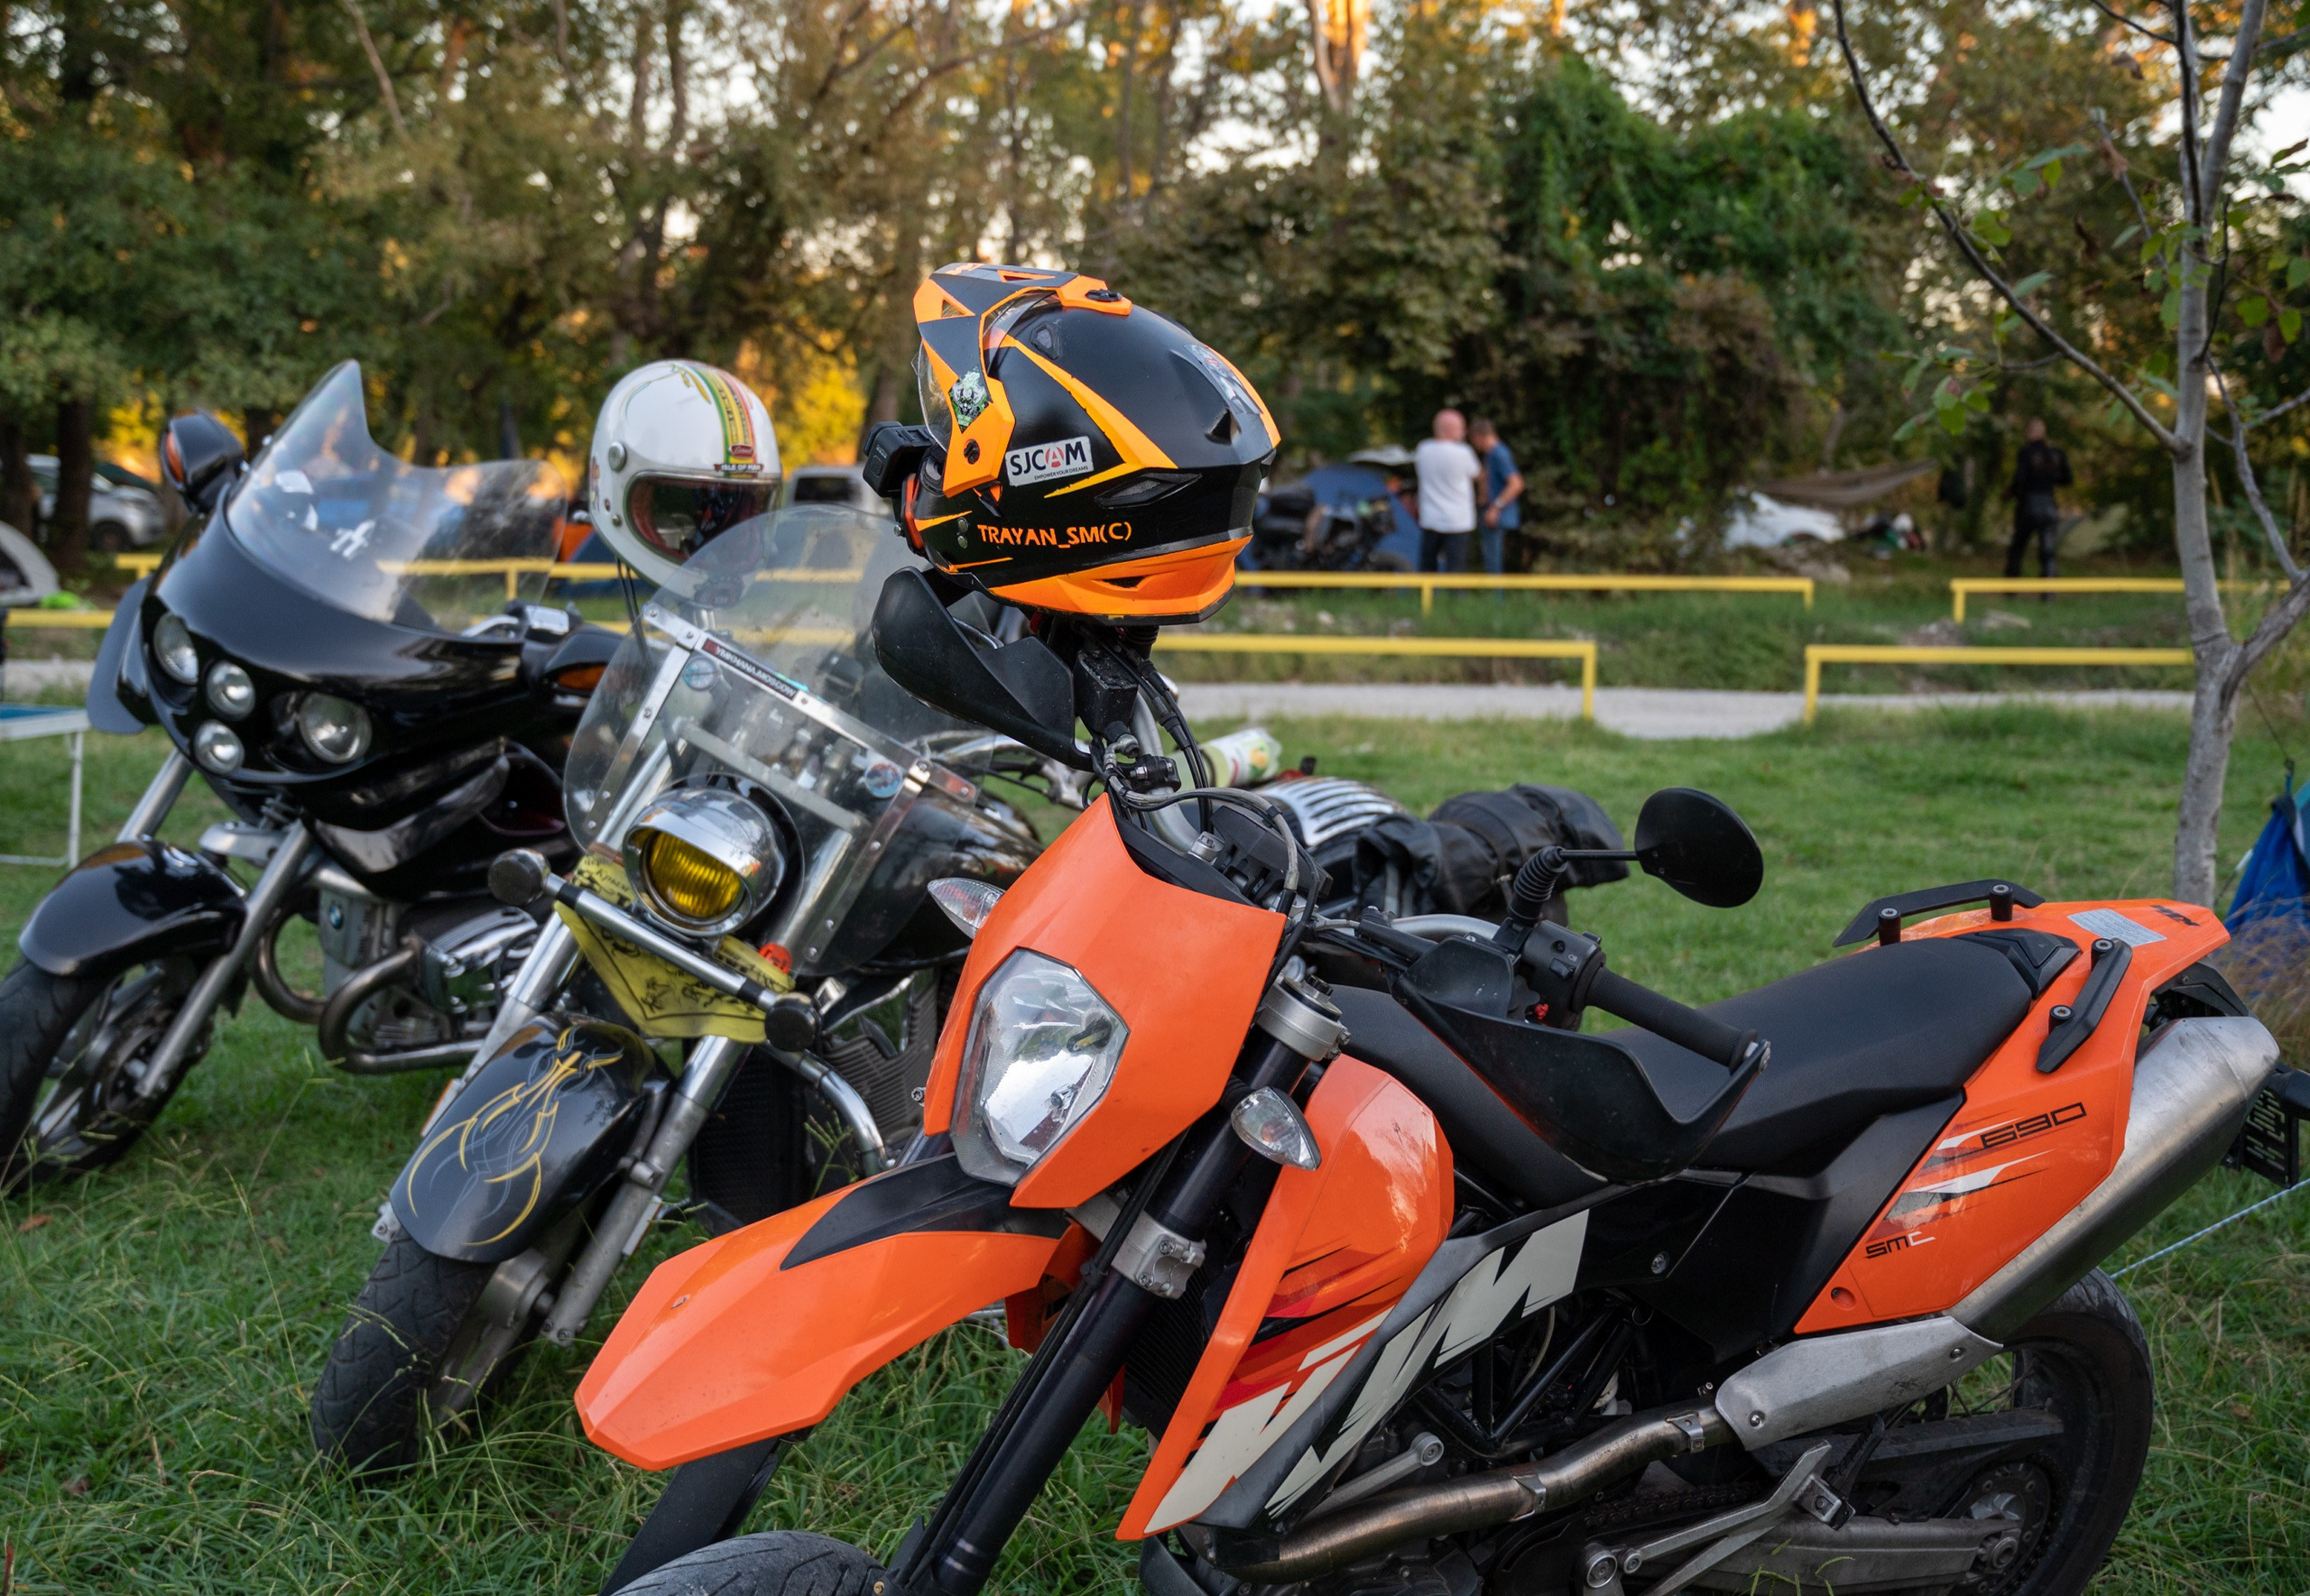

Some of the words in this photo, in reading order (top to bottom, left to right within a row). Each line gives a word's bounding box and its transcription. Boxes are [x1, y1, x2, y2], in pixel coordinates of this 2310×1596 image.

[1010, 440, 1086, 476] SJCAM
[1034, 472, 1057, 481] EMPOWER
[1056, 468, 1069, 476] YOUR
[1068, 465, 1089, 474] DREAMS
[977, 521, 1132, 549] TRAYAN_SM(C)
[1979, 1102, 2087, 1149] 690
[1864, 1231, 1936, 1259] SMC
